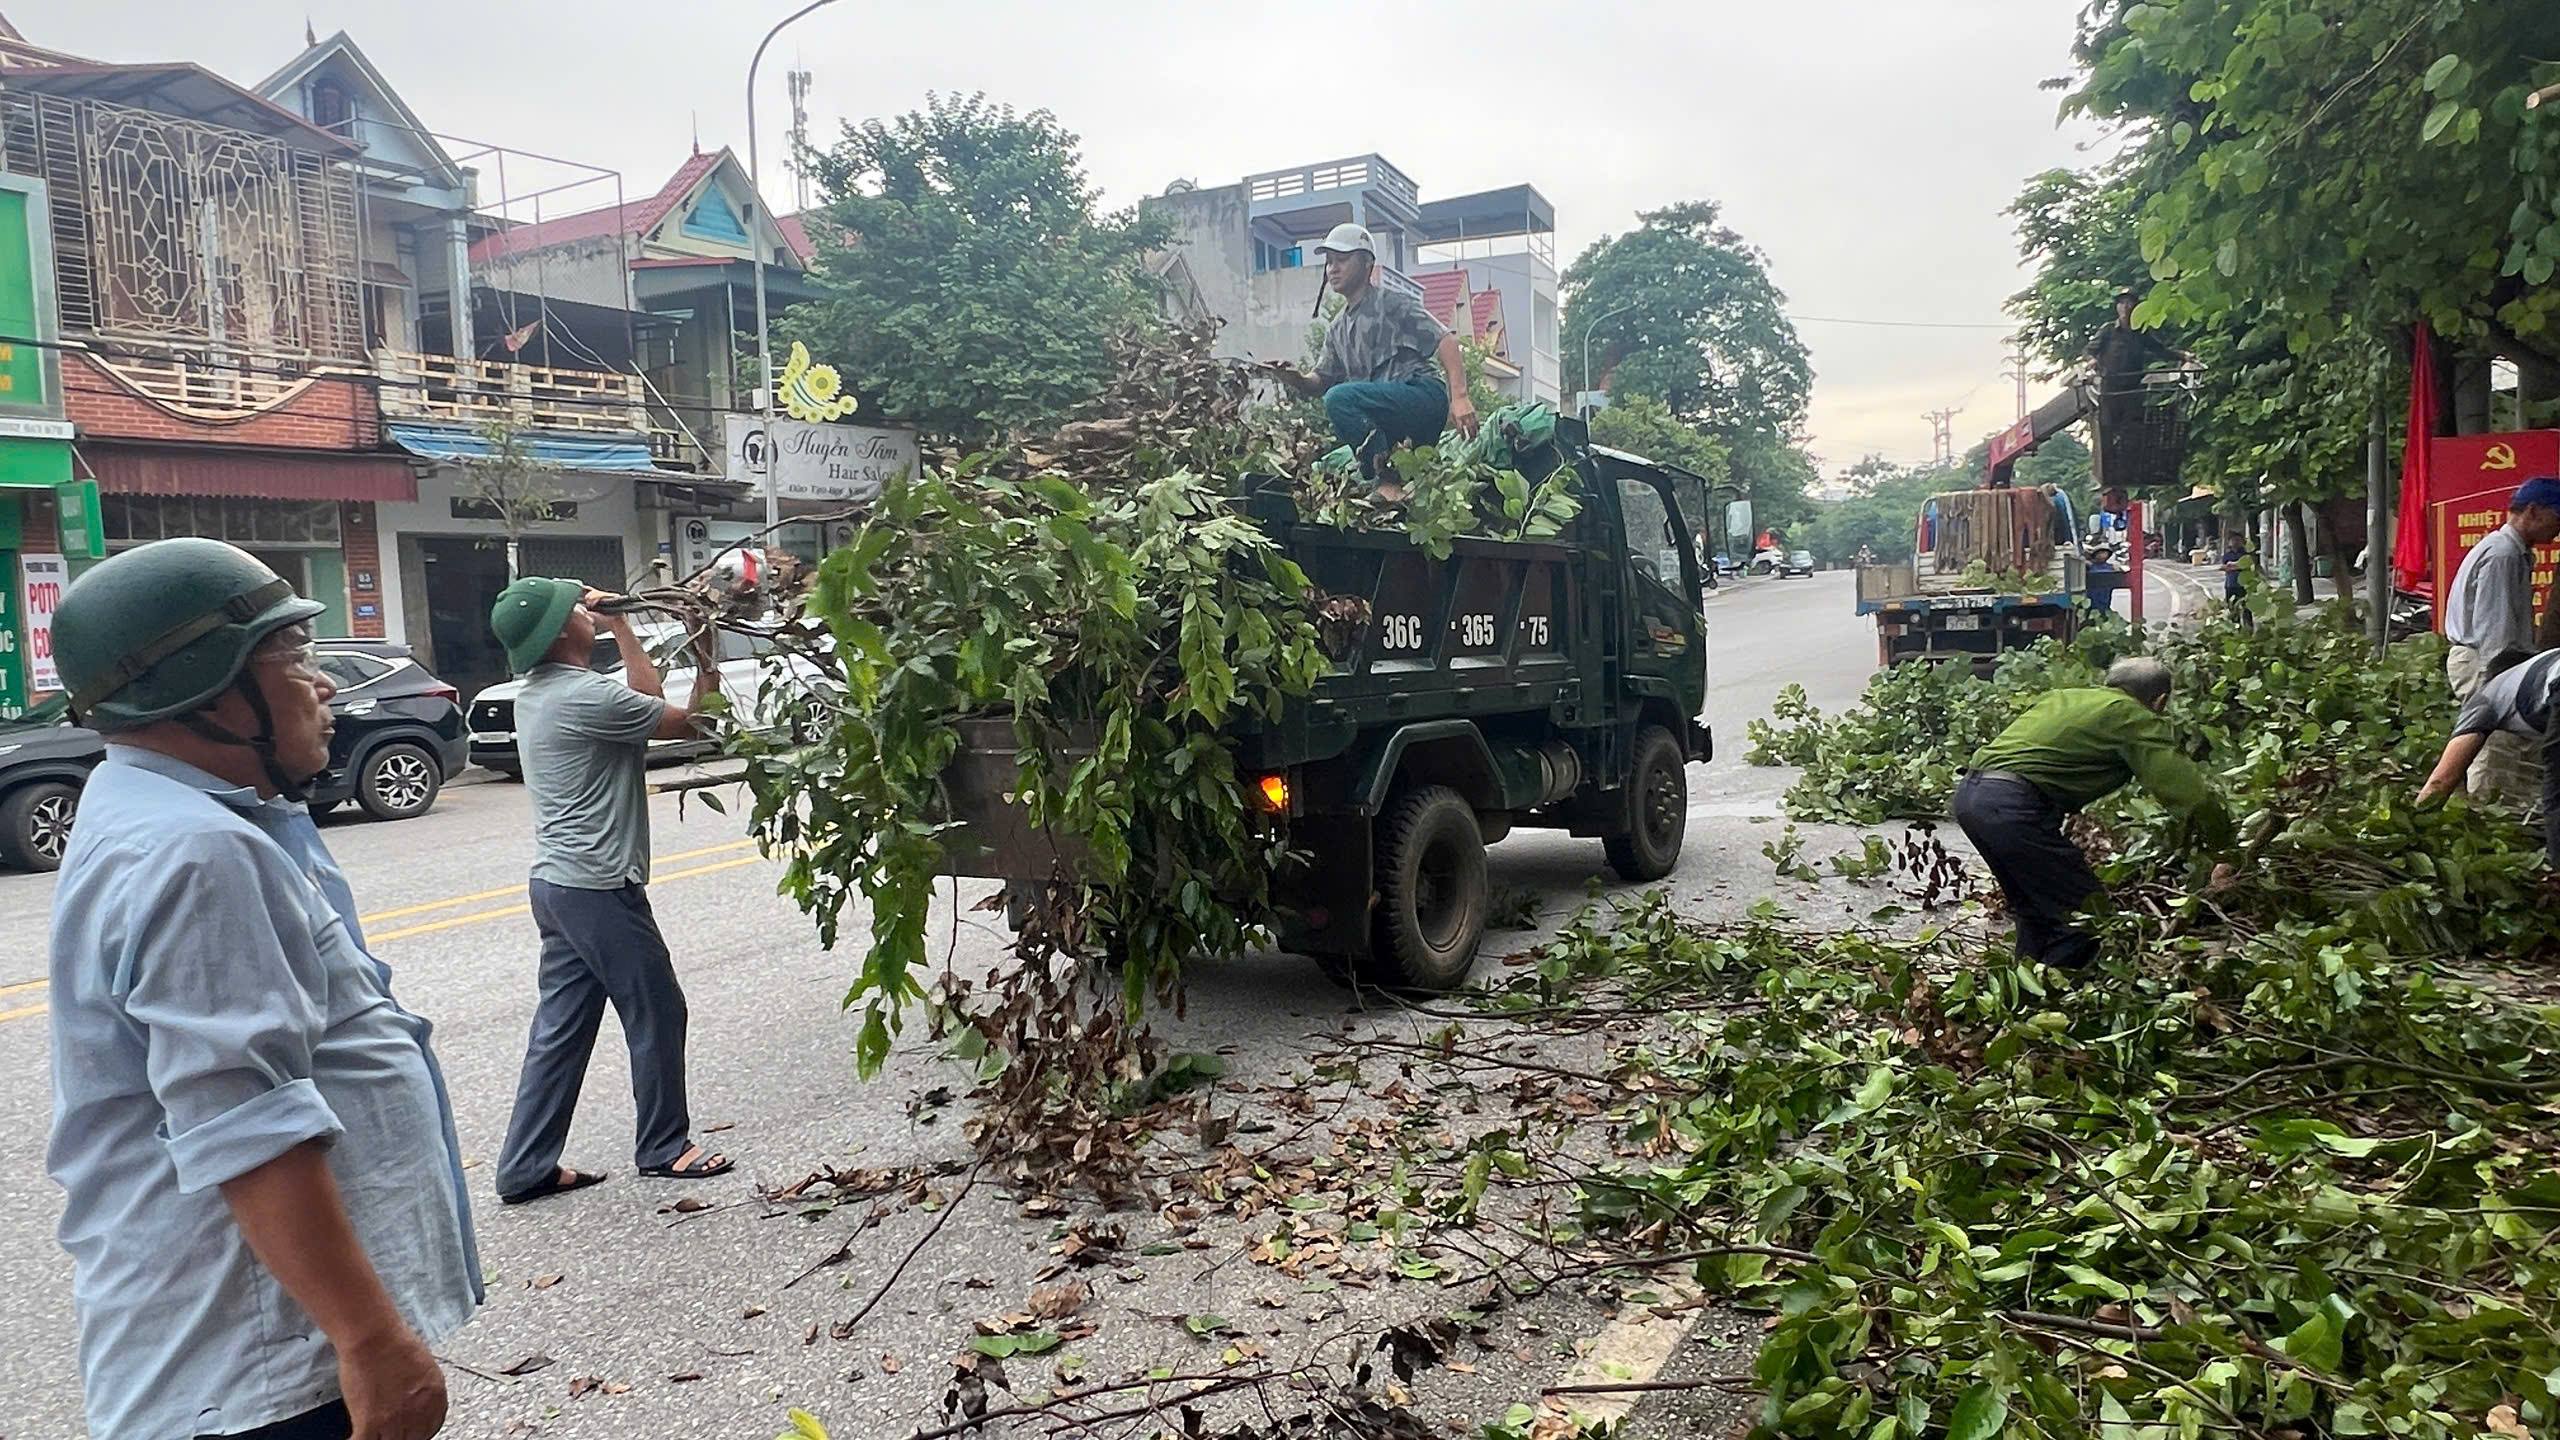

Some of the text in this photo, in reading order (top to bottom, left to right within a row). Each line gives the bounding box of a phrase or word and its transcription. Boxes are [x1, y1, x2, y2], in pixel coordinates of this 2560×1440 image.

[783, 430, 898, 465] Huyền Tâm
[829, 464, 859, 480] Hair
[2458, 509, 2503, 528] NHIỆT
[1383, 614, 1548, 649] 36C 365 75
